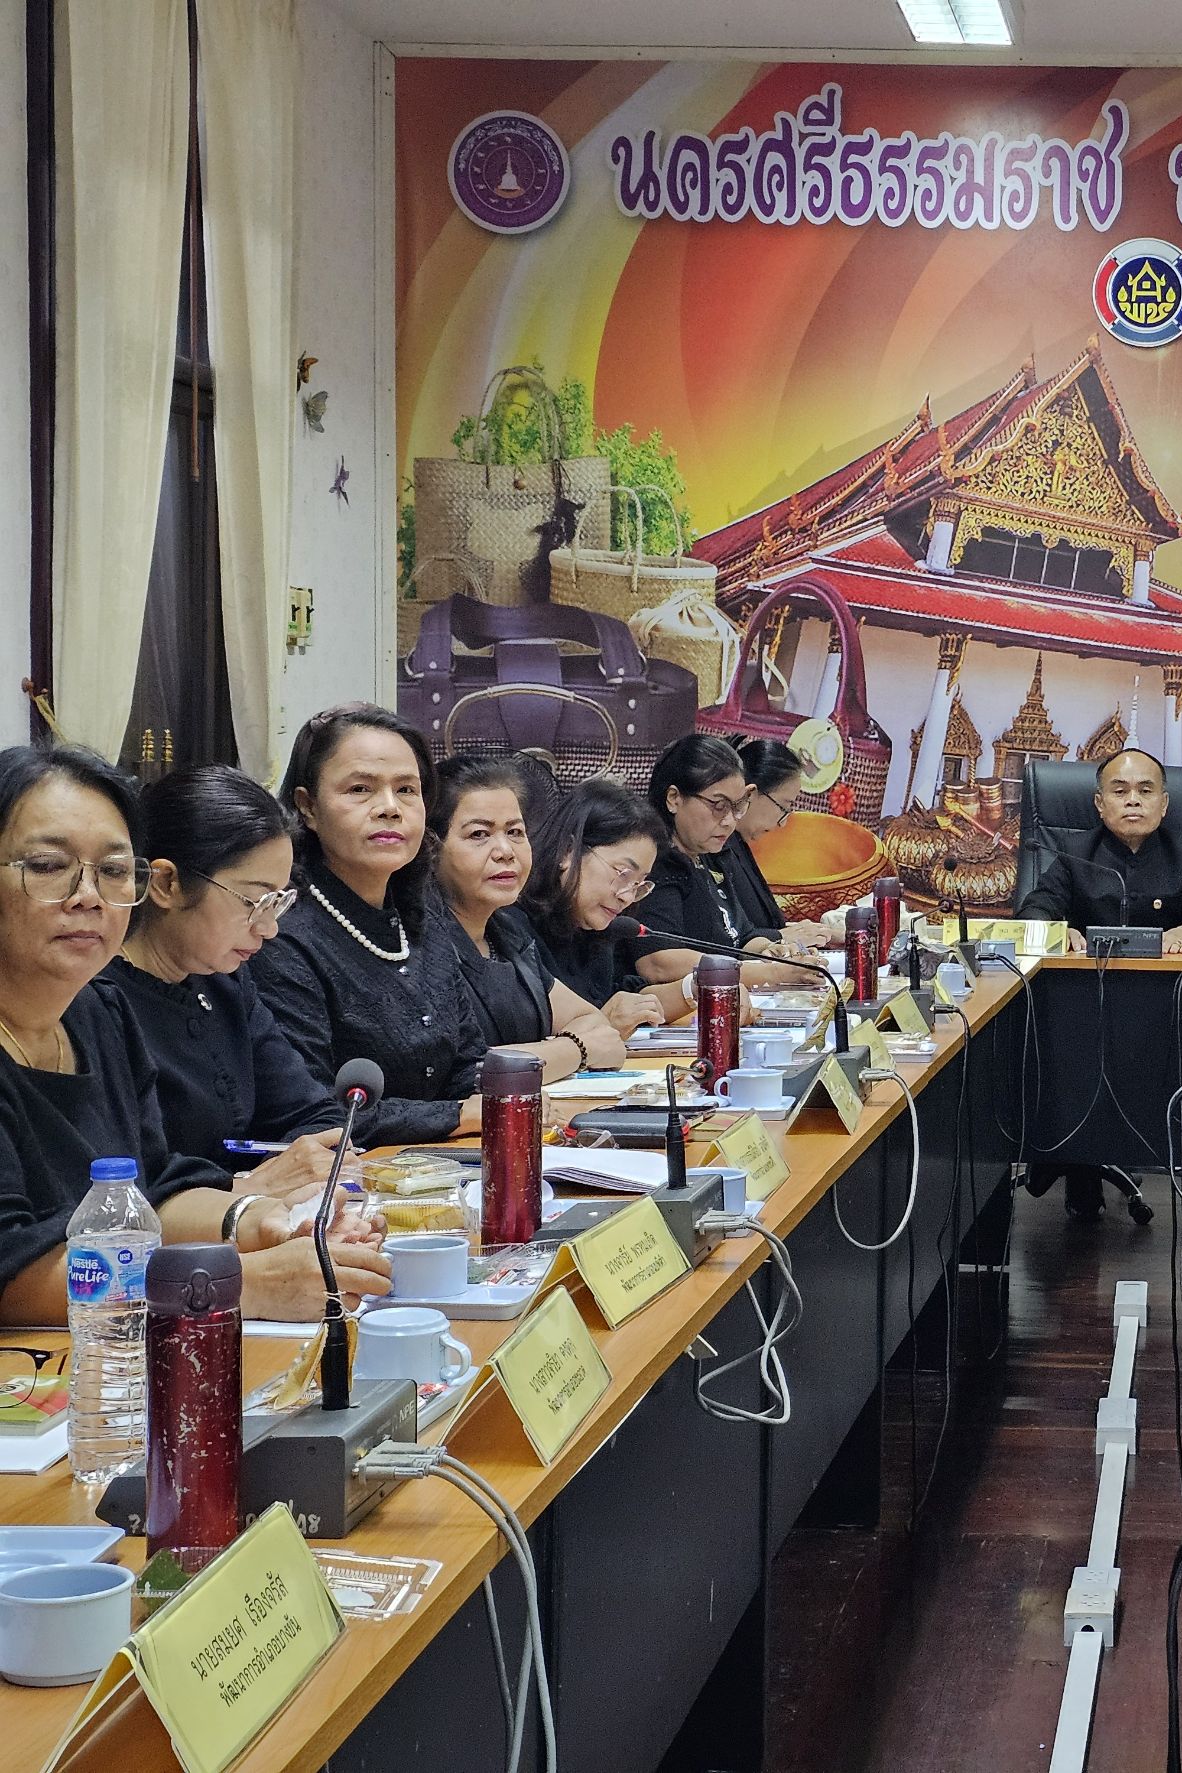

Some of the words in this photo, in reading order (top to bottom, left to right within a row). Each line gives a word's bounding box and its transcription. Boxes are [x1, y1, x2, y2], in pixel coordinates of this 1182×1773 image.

[608, 85, 1125, 228] นครศรีธรรมราช
[190, 1615, 248, 1682] นายสมยศ
[244, 1570, 289, 1627] เรืองจรัส
[218, 1612, 302, 1708] พัฒนาการอำเภอบางขัน
